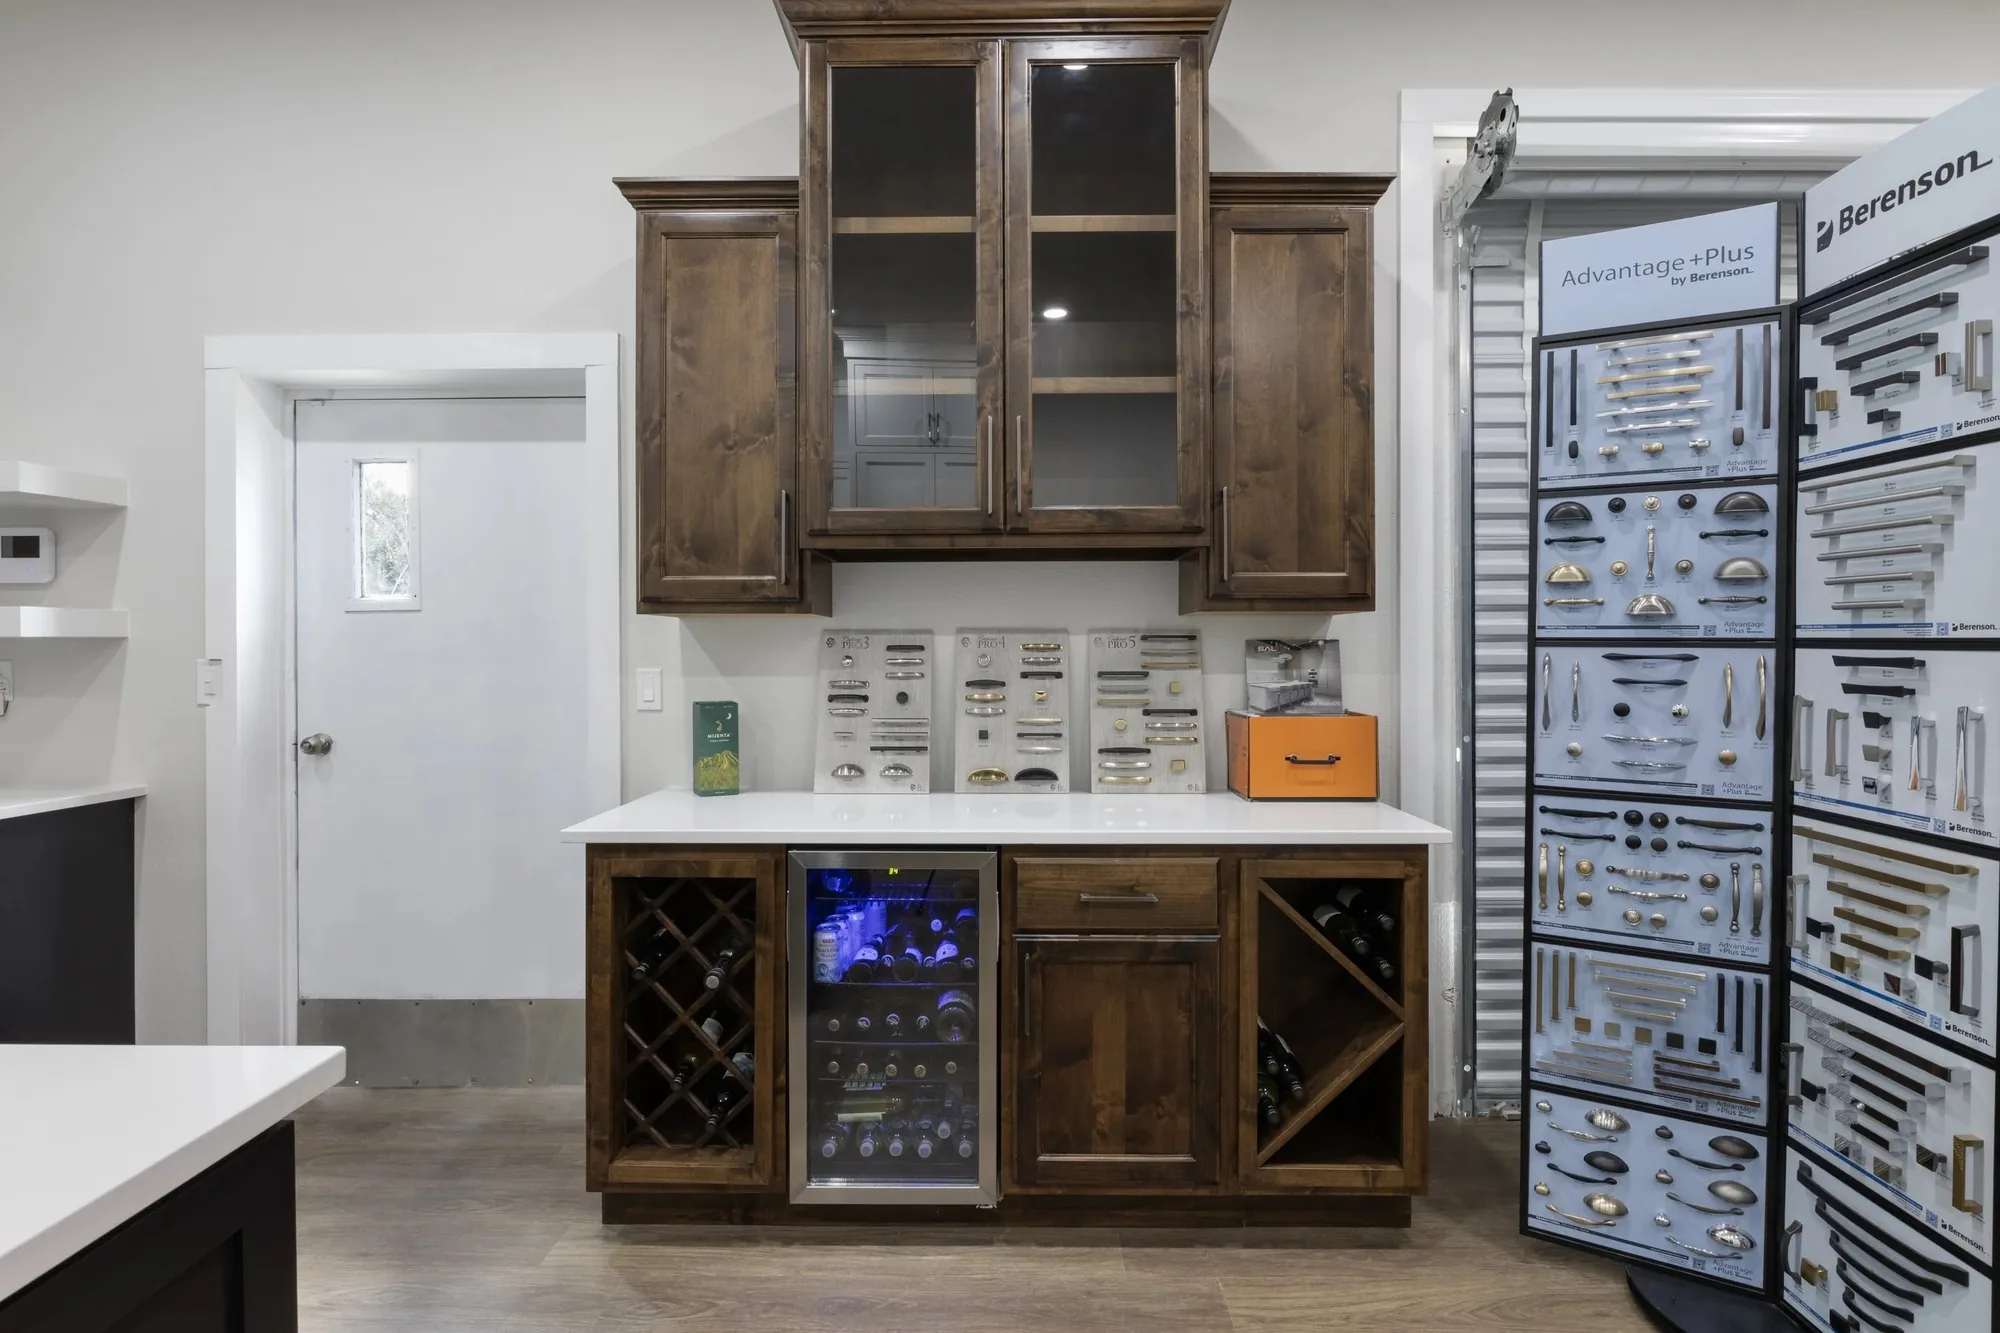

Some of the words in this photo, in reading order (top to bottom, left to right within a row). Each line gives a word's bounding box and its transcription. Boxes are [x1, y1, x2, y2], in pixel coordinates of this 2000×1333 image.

[1839, 150, 1993, 236] Berenson
[1562, 257, 1685, 287] Advantage
[1671, 277, 1687, 286] by
[1690, 266, 1754, 283] Berenson
[1963, 414, 2000, 429] Berenson
[1727, 459, 1768, 467] Advantage
[1723, 621, 1765, 629] Advantage
[1959, 622, 1996, 631] Berenson
[1721, 781, 1763, 790] Advantage
[1956, 823, 1995, 838] Berenson
[1718, 941, 1760, 953] Advantage
[1952, 1024, 1990, 1046] Berenson
[1716, 1100, 1757, 1114] Advantage
[1948, 1224, 1986, 1252] Berenson
[1712, 1259, 1754, 1276] Advantage
